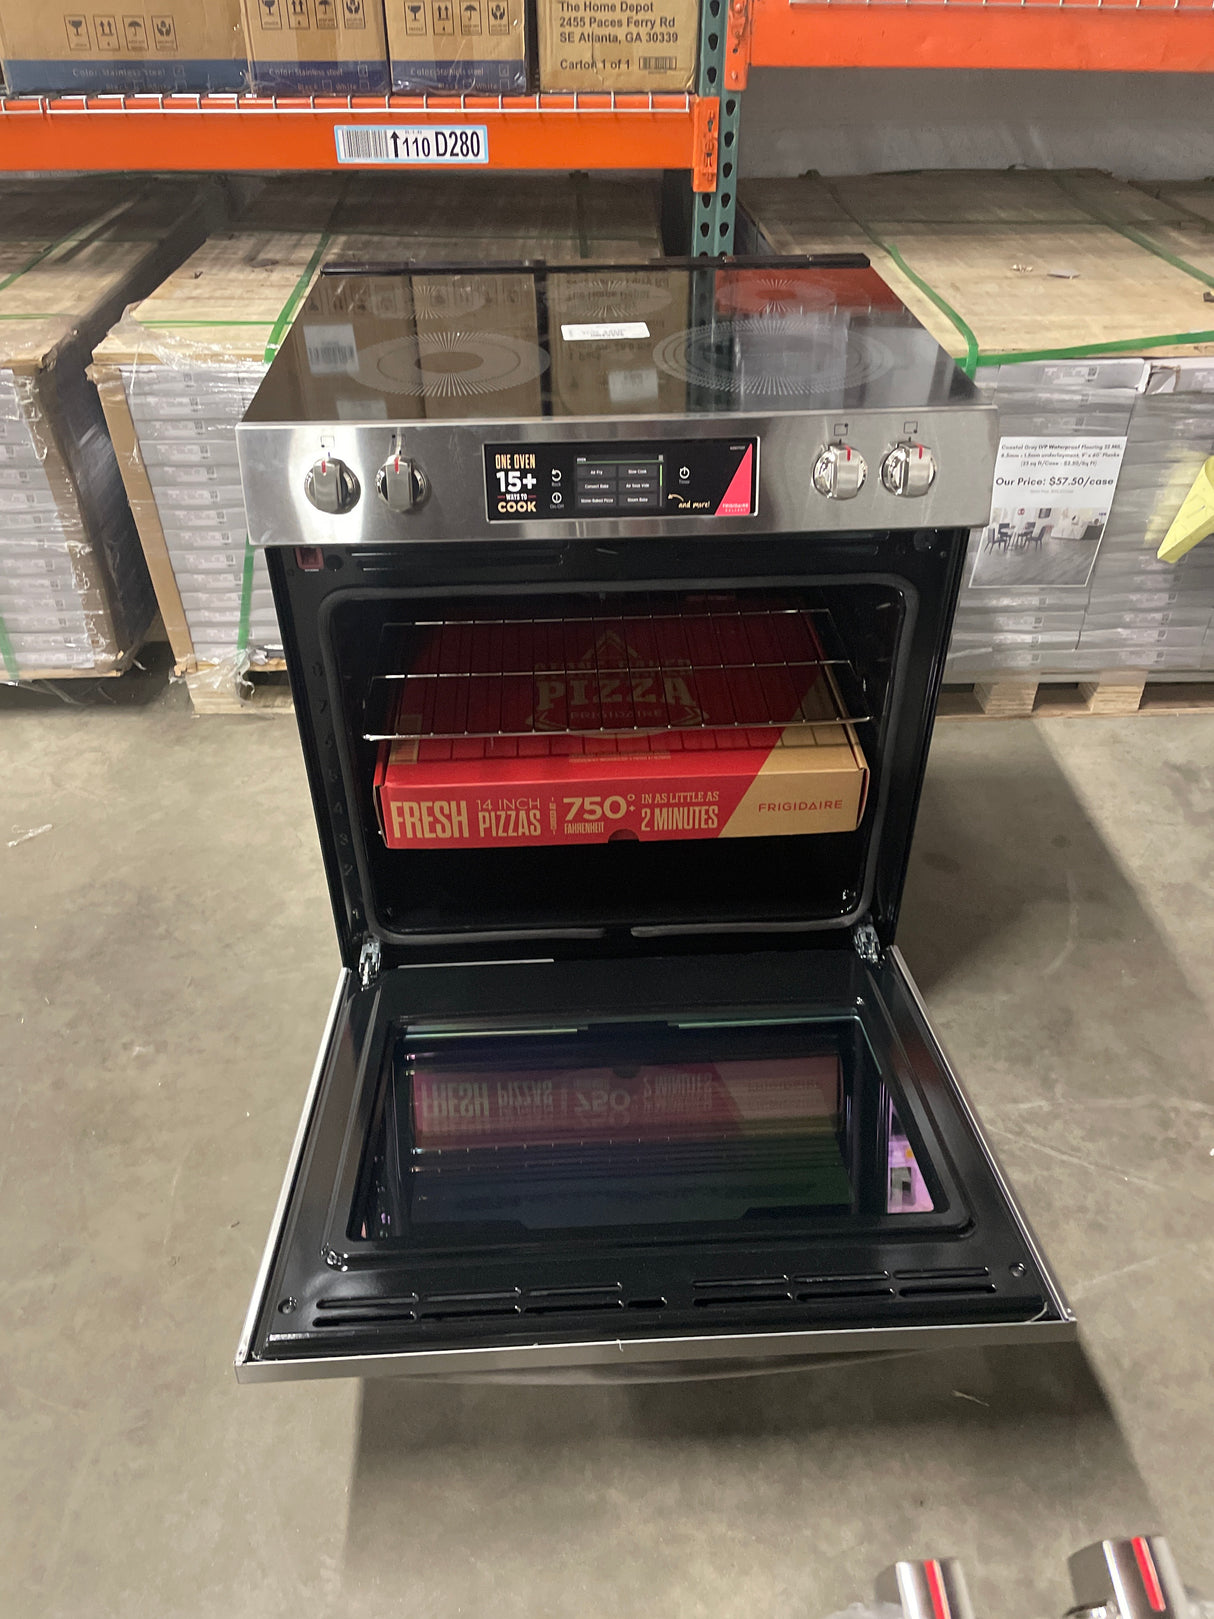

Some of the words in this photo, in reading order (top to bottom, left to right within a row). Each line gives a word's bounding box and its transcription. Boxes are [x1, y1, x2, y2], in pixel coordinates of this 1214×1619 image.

[560, 1, 581, 13] The
[584, 2, 617, 13] Home
[620, 1, 654, 15] Depot
[560, 17, 586, 28] 2455
[589, 17, 623, 28] Paces
[626, 17, 656, 30] Ferry
[660, 17, 676, 28] Rd
[560, 32, 575, 43] SE
[578, 32, 622, 44] Atlanta,
[625, 32, 643, 43] GA
[646, 32, 679, 43] 30339
[560, 59, 597, 70] Carton
[601, 59, 606, 69] 1
[610, 59, 622, 69] of
[625, 59, 630, 69] 1
[402, 137, 431, 157] 110
[434, 130, 481, 157] D280
[495, 453, 512, 469] ONE
[514, 453, 536, 469] OVEN
[496, 470, 537, 493] 15+
[995, 476, 1015, 487] Our
[1017, 476, 1046, 487] Price:
[1048, 476, 1114, 488] $57.50/case
[505, 493, 520, 501] WAYS
[497, 501, 537, 513] COOK
[678, 500, 691, 509] and
[692, 500, 711, 510] more!
[536, 677, 698, 711] PIZZA
[570, 708, 664, 721] FRIGIDAIRE
[475, 798, 493, 811] 14
[498, 797, 541, 810] INCH
[641, 793, 652, 804] IN
[653, 793, 668, 804] AS
[669, 792, 705, 803] LITTLE
[706, 791, 720, 802] AS
[758, 799, 843, 813] FRIGIDAIRE
[390, 800, 470, 839] FRESH
[478, 809, 542, 838] PIZZAS
[641, 808, 651, 832] 2
[653, 805, 719, 831] MINUTES
[564, 821, 605, 835] FAHRENHEIT
